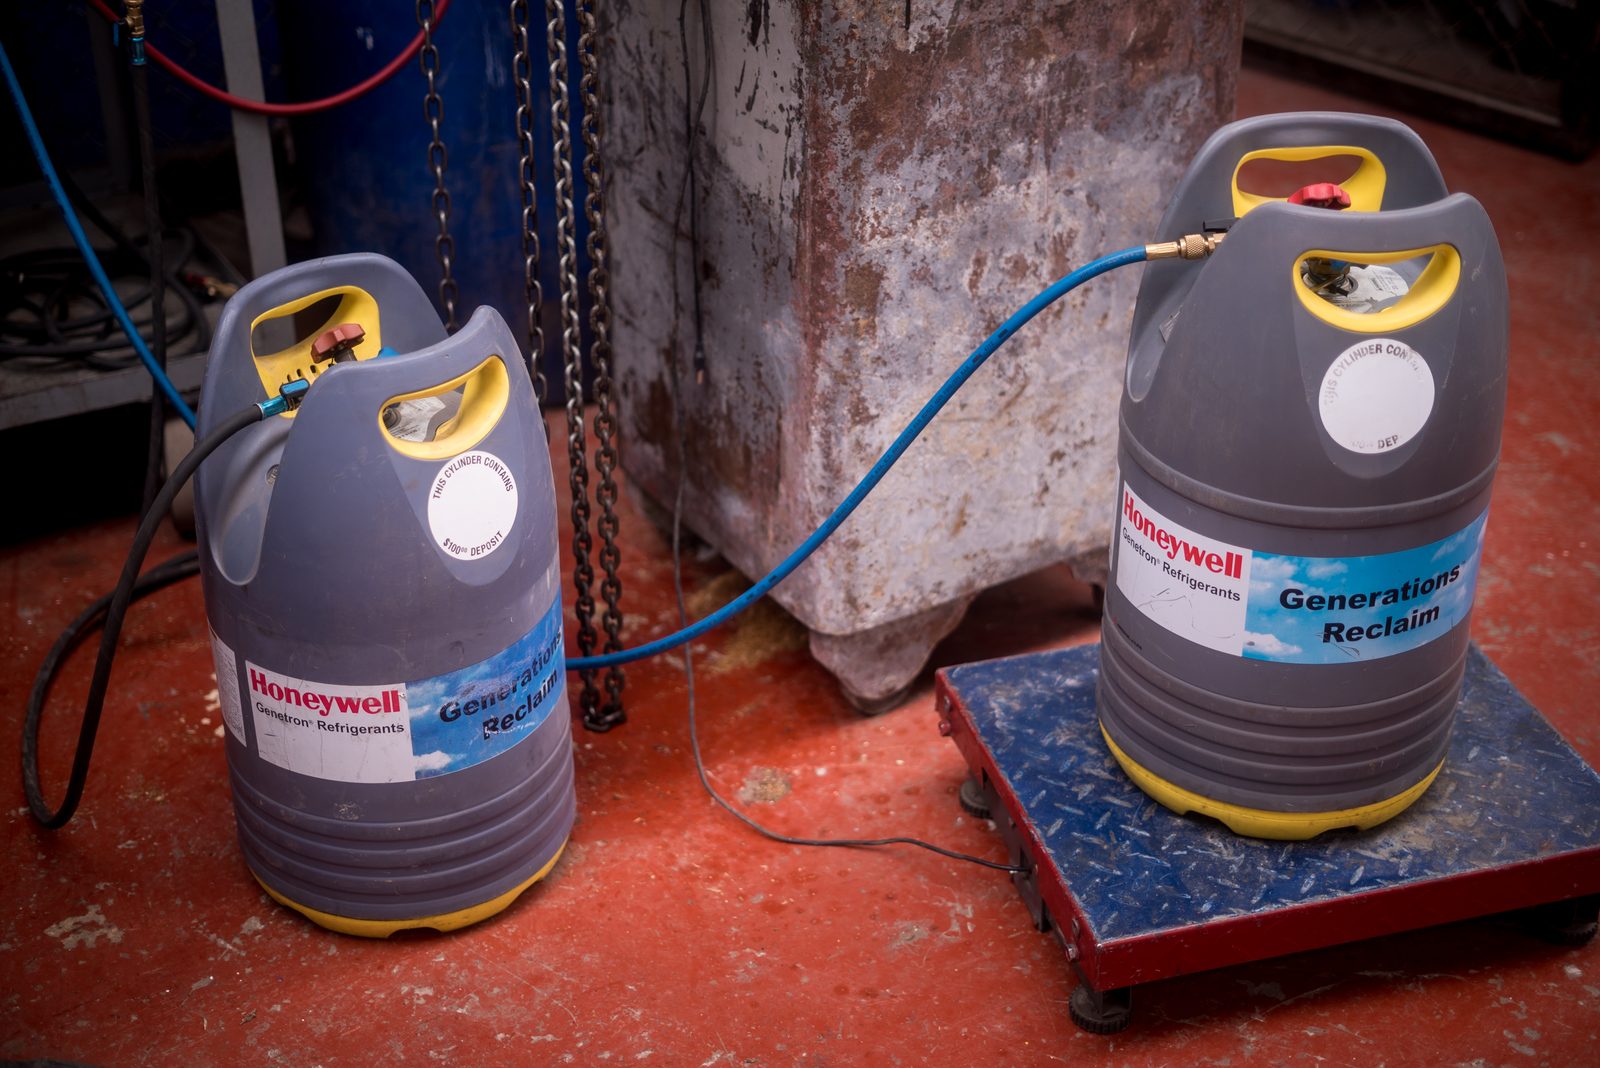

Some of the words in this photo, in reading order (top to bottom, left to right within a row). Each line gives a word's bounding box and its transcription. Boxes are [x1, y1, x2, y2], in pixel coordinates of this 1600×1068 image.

[1333, 344, 1382, 377] CYLINDER
[432, 478, 447, 499] THIS
[444, 455, 482, 478] CYLINDER
[484, 457, 514, 492] CONTAINS
[470, 530, 503, 556] DEPOSIT
[1123, 490, 1243, 580] Honeywell
[1163, 561, 1241, 602] Refrigerants
[1279, 564, 1460, 611] Generations
[1323, 605, 1440, 644] Reclaim
[250, 668, 401, 717] Honeywell
[439, 631, 561, 723] Generations
[482, 669, 558, 741] Reclaim
[317, 720, 405, 737] Refrigerants
